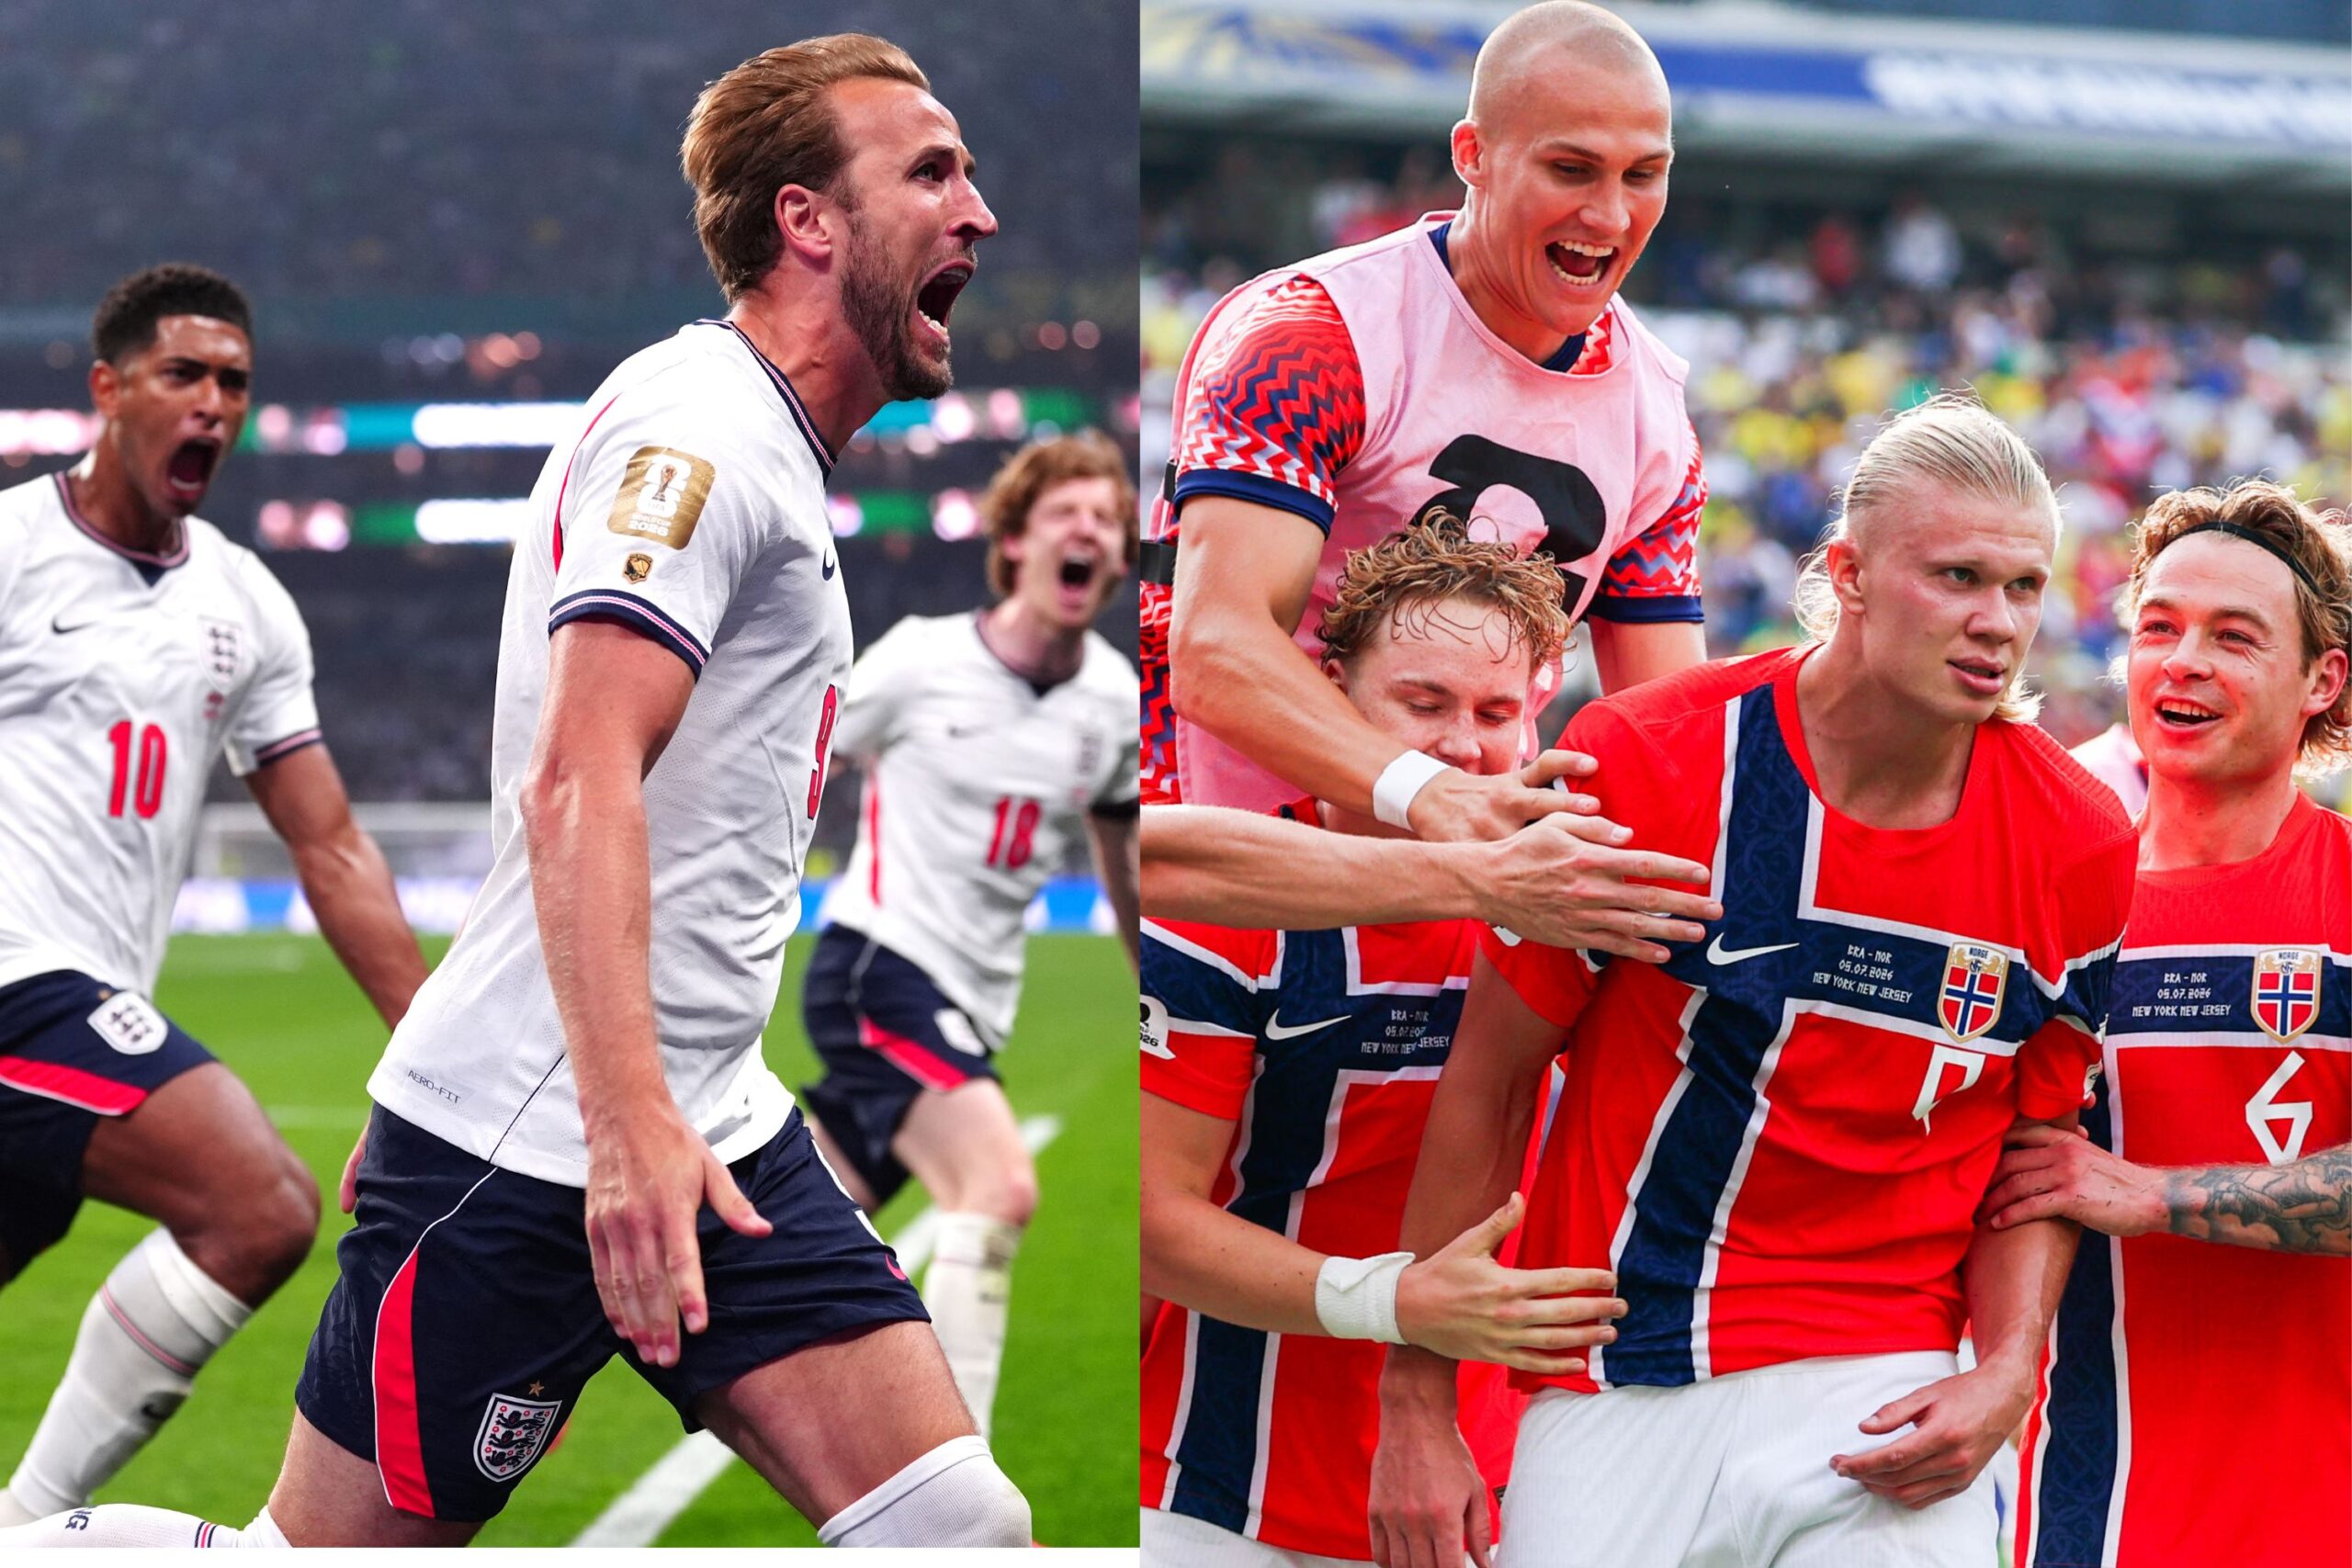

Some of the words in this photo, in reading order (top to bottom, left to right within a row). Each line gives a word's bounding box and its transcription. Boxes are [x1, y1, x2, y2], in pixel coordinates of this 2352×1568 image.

[628, 520, 669, 536] 2026
[808, 683, 837, 820] 9
[108, 720, 167, 819] 10
[985, 795, 1042, 869] 18
[1847, 944, 1865, 959] BRA
[1874, 950, 1893, 964] NOR
[1969, 947, 1989, 959] NORGE
[1838, 959, 1894, 981] 05.07.2026
[2164, 973, 2181, 984] BRA
[2190, 973, 2208, 984] NOR
[1813, 972, 1832, 985] NEW
[1833, 975, 1857, 992] YORK
[1857, 982, 1878, 996] NEW
[1878, 987, 1913, 1003] JERSEY
[2157, 987, 2211, 999] 05.07.2026
[1391, 1010, 1407, 1021] BRA
[2132, 1005, 2152, 1017] NEW
[2154, 1005, 2178, 1017] YORK
[2179, 1005, 2199, 1017] NEW
[2200, 1004, 2232, 1016] JERSEY
[1361, 1042, 1380, 1054] NEW
[1381, 1043, 1399, 1054] YORK
[1418, 1036, 1450, 1048] JERSEY
[408, 1069, 461, 1103] AERO-FIT
[2245, 1050, 2313, 1168] 6
